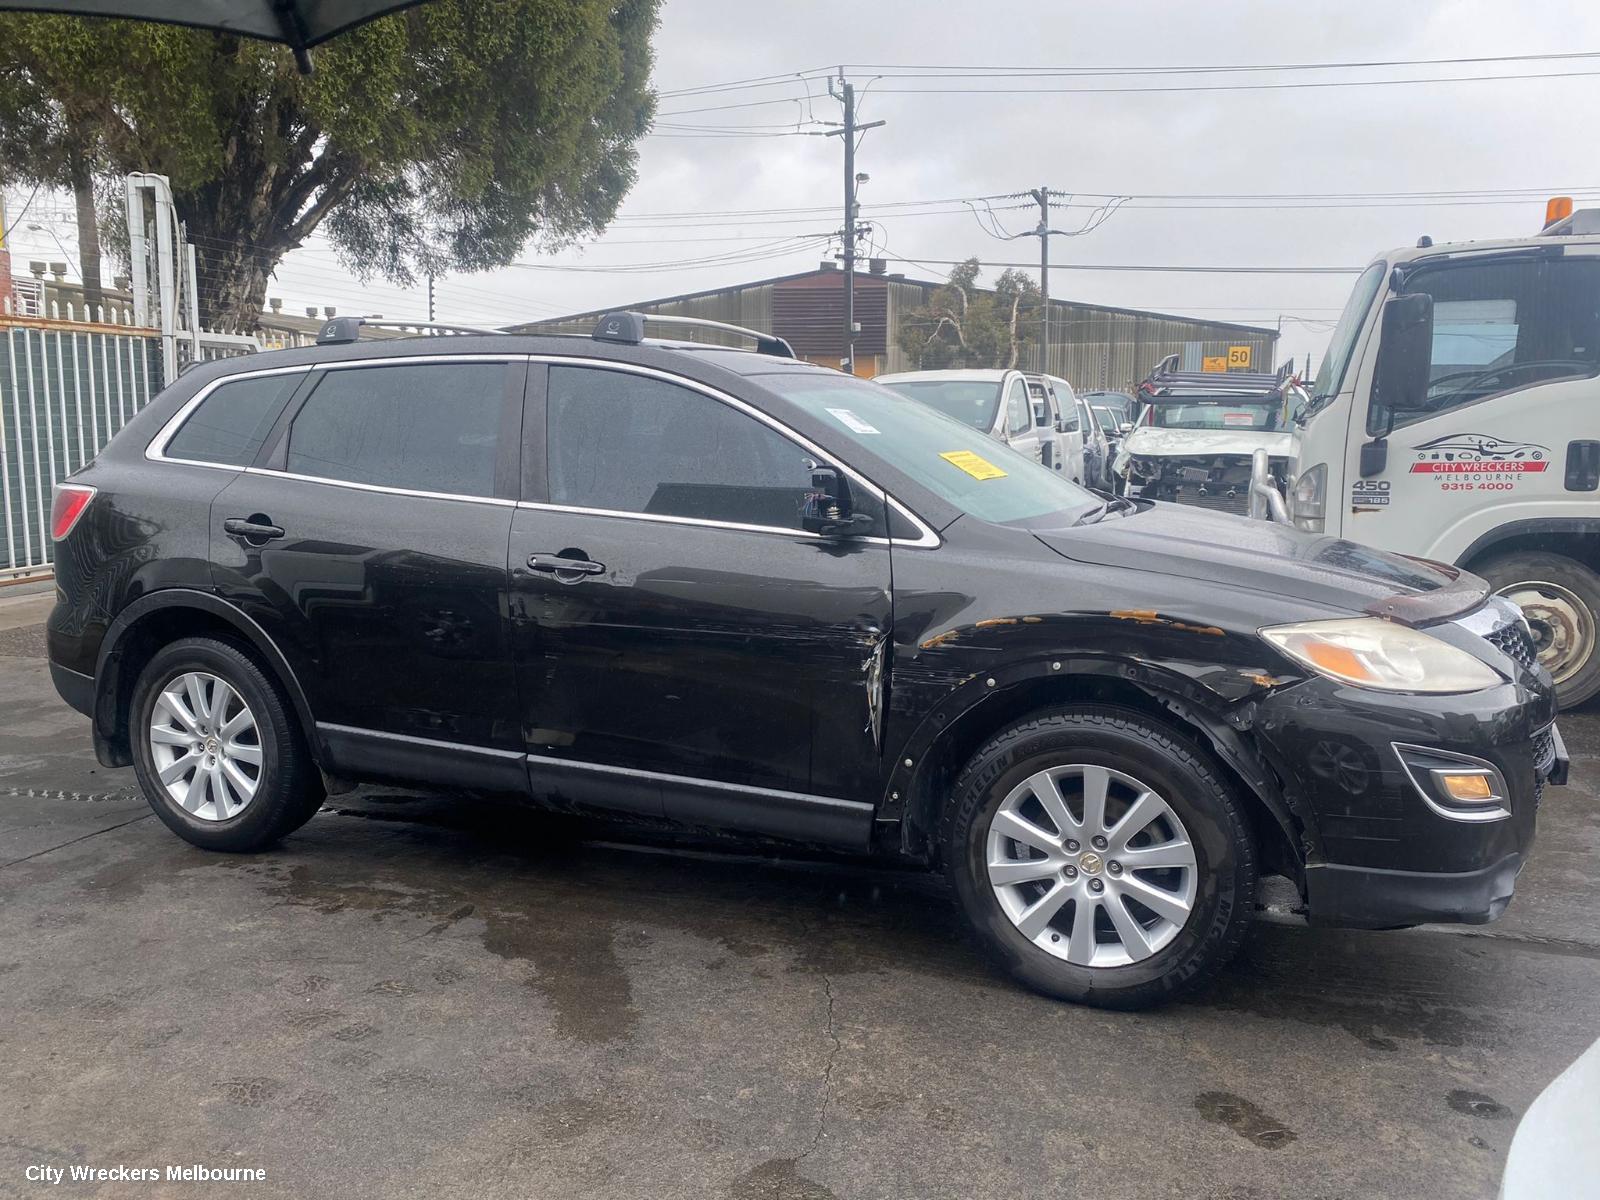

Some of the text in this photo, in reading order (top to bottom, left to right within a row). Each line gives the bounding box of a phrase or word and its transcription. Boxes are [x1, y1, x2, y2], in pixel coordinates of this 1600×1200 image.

[1231, 351, 1248, 363] 50
[1432, 462, 1525, 472] CITY WRECKERS
[1434, 473, 1523, 481] MELBOURNE
[1352, 480, 1391, 490] 450
[954, 754, 1010, 834] MICHELIN
